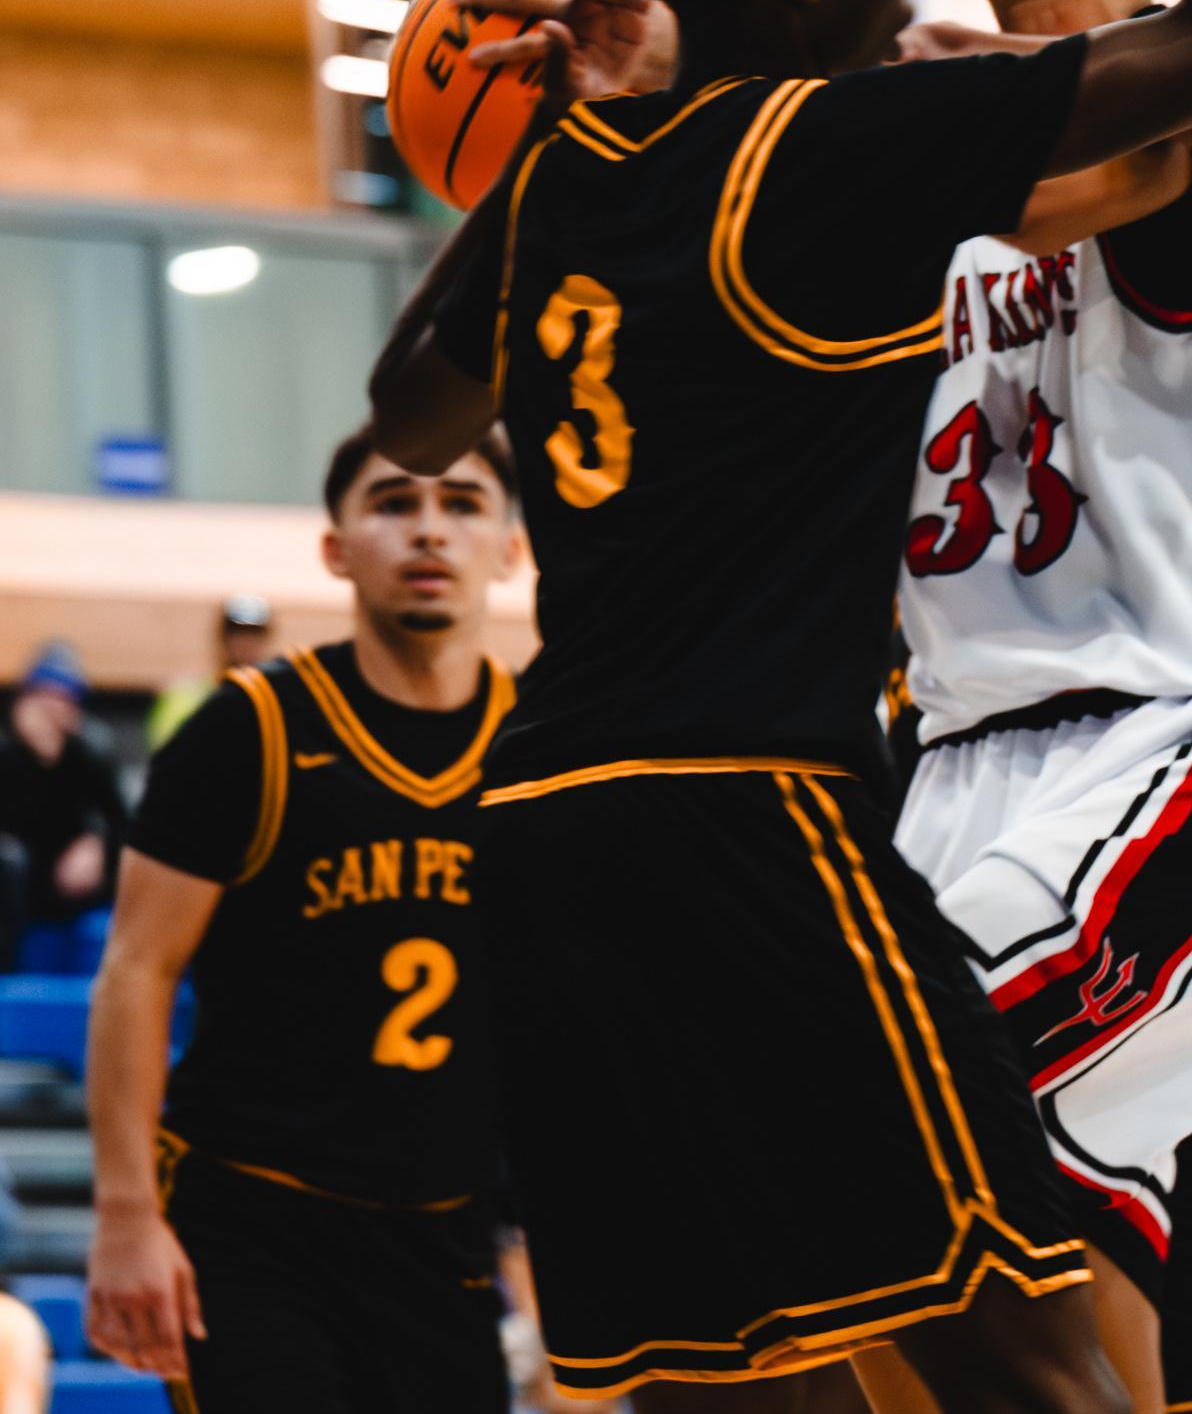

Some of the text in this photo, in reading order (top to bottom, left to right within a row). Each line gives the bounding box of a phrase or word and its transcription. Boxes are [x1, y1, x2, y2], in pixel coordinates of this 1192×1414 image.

[424, 5, 491, 91] EV
[535, 273, 638, 510] 3
[904, 386, 1088, 578] 33
[303, 838, 403, 919] SAN
[372, 936, 459, 1071] 2
